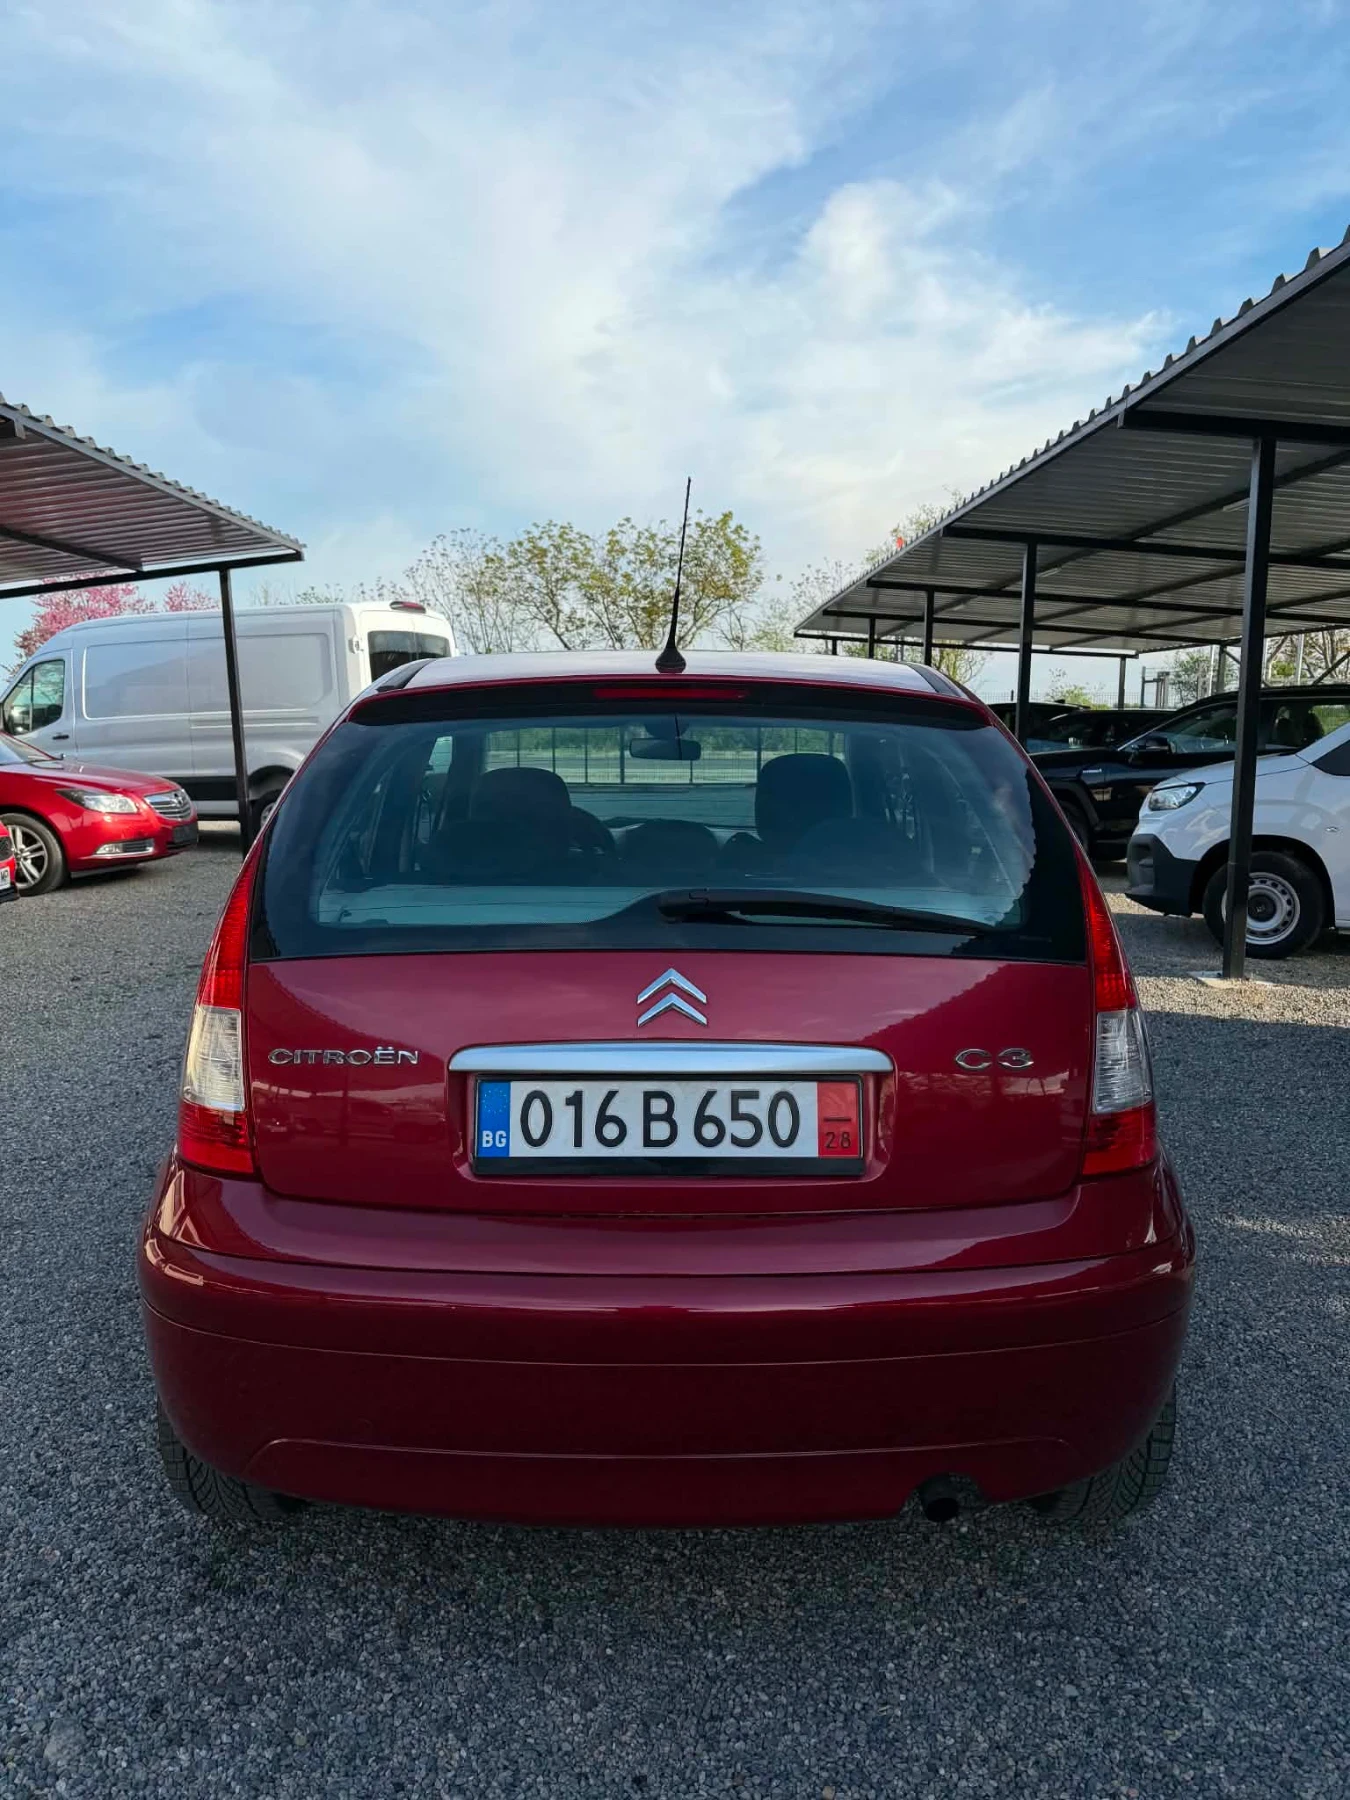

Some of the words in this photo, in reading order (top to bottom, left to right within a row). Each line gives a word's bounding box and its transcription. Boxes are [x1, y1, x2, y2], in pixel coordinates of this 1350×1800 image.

[268, 1046, 419, 1065] CITROËN
[955, 1048, 1035, 1070] C3
[482, 1130, 507, 1148] BG
[825, 1131, 852, 1149] 28
